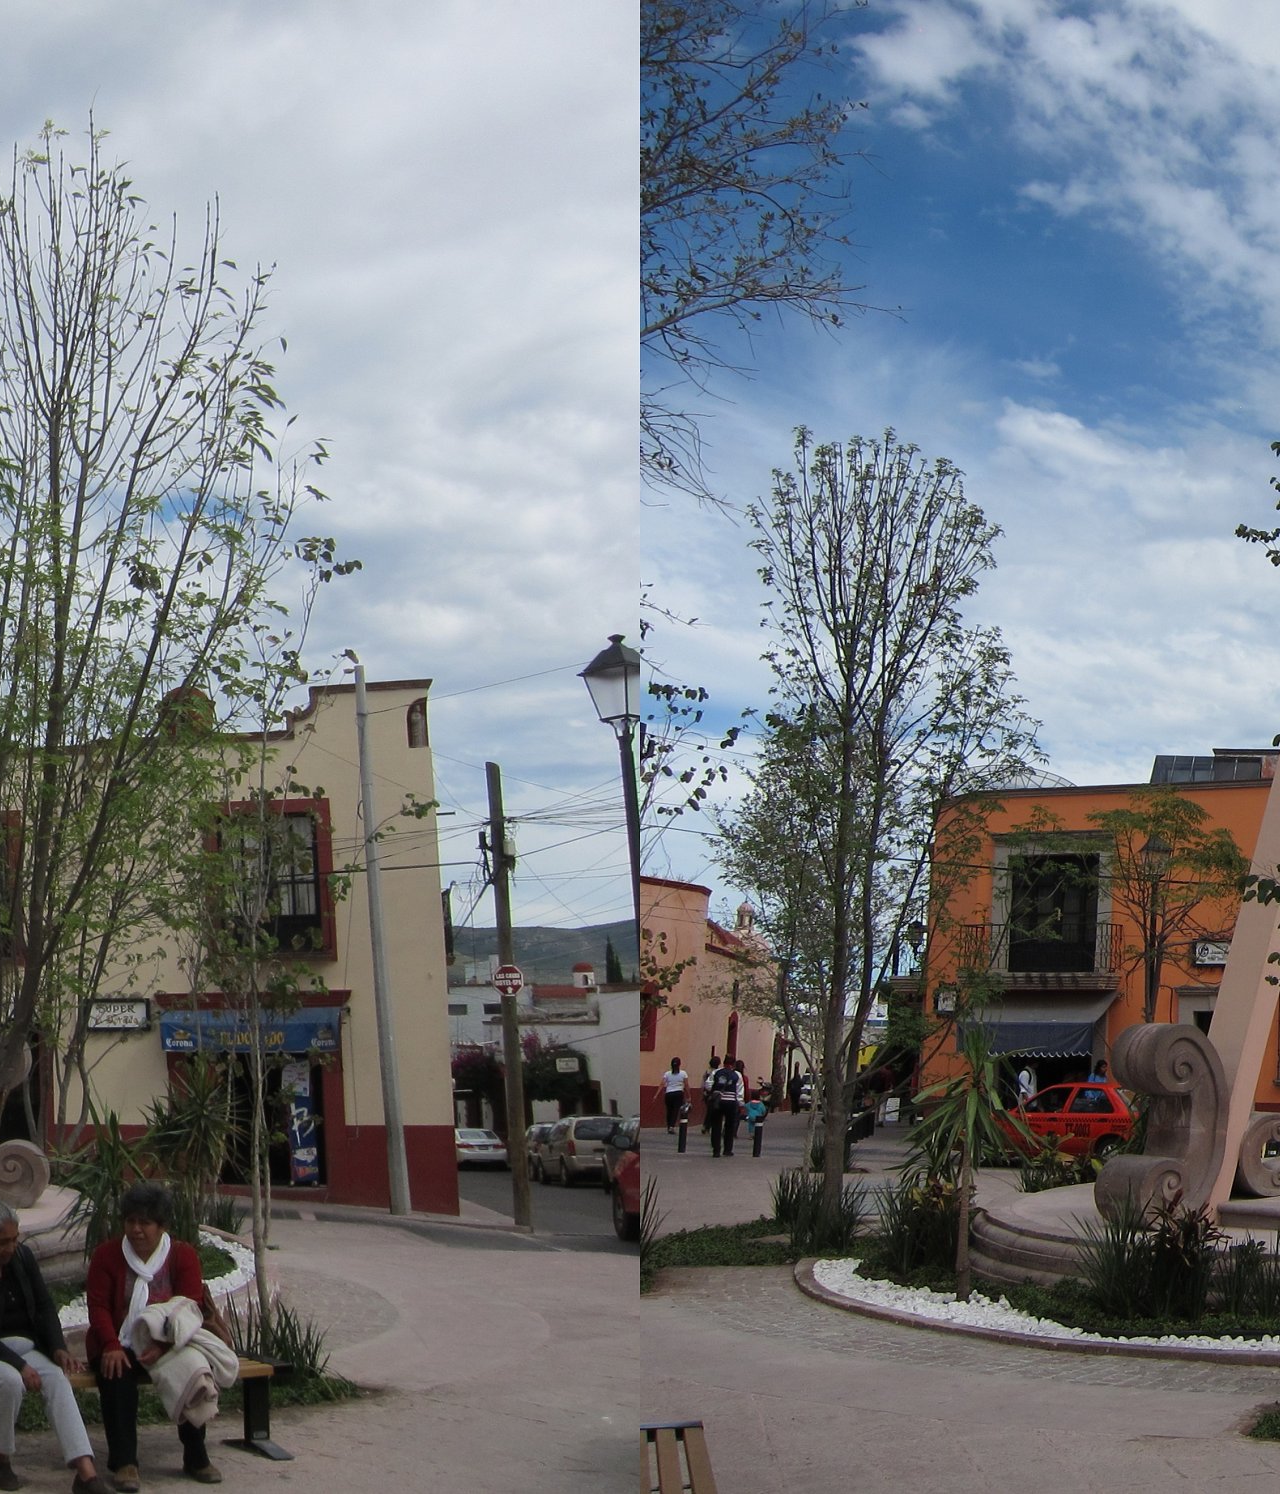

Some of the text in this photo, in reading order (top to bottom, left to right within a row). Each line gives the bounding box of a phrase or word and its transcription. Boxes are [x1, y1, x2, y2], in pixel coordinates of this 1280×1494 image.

[96, 1003, 136, 1013] SUPER
[165, 1037, 194, 1048] Corona
[236, 1031, 285, 1045] DODO
